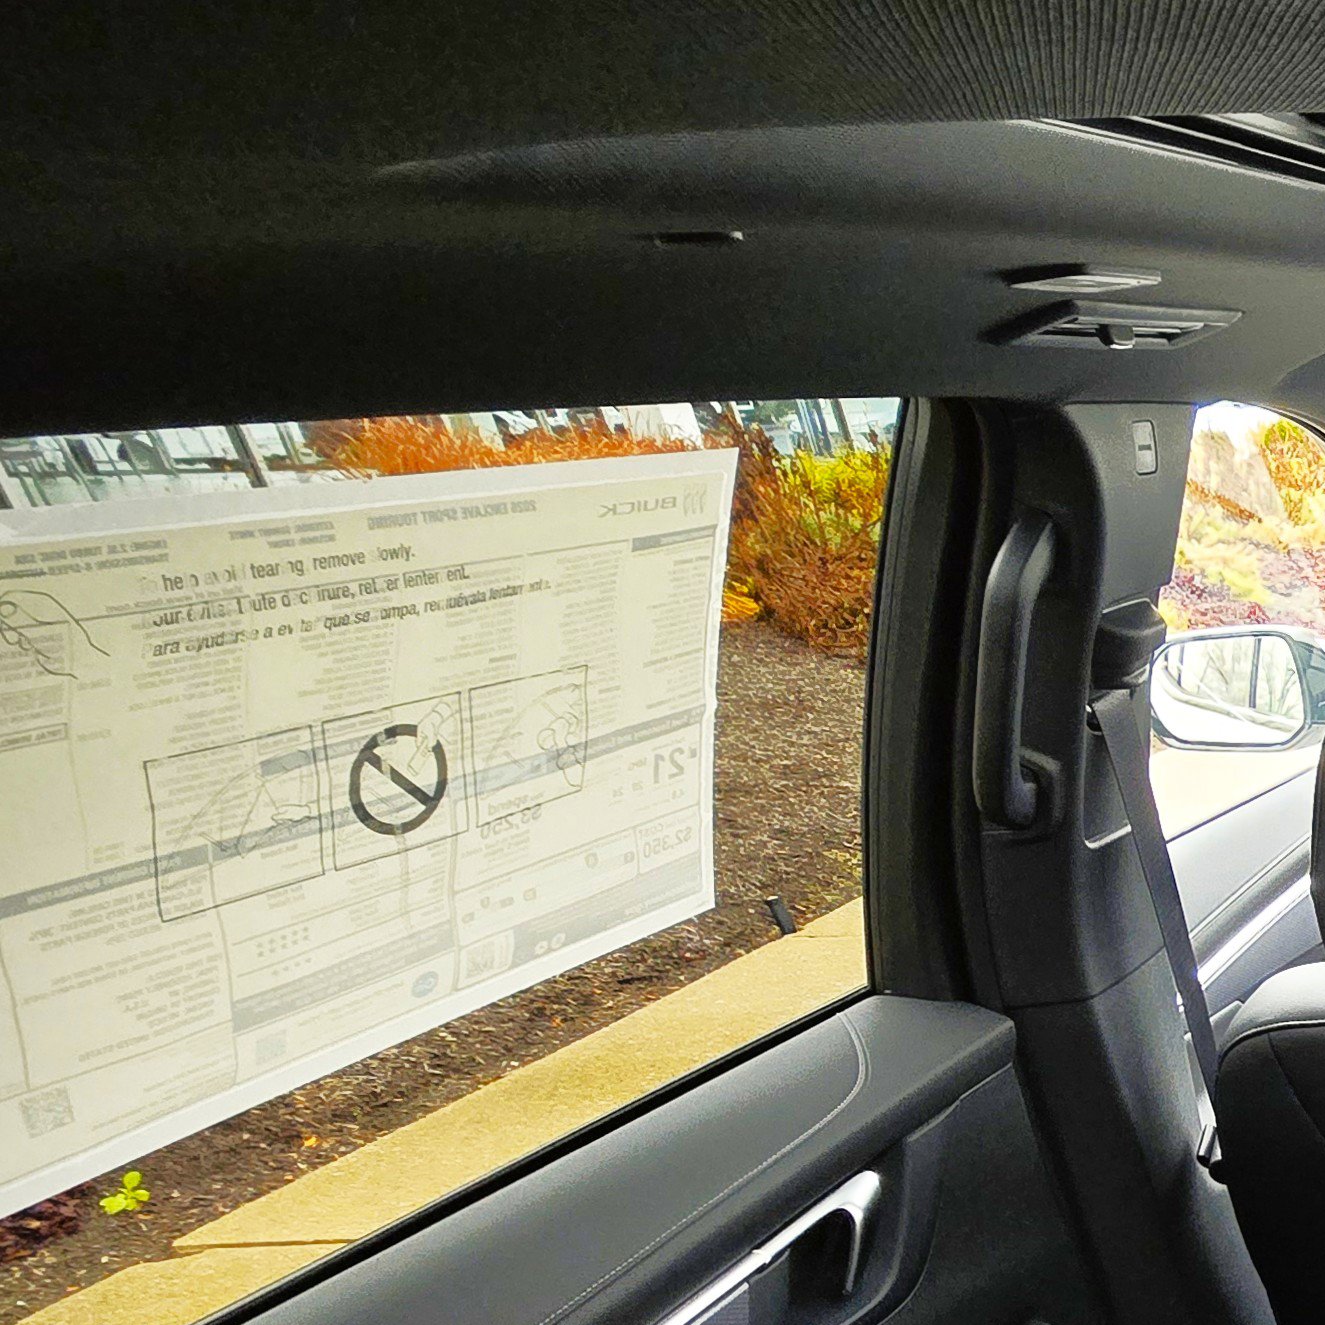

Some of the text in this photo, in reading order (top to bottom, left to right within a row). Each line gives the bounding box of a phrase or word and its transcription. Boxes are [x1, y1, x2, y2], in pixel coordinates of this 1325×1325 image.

[162, 573, 200, 593] hep
[250, 559, 305, 580] tearng
[312, 551, 366, 571] remove
[263, 625, 274, 639] a
[323, 613, 350, 631] que
[354, 610, 371, 625] se
[379, 603, 420, 620] ompa,
